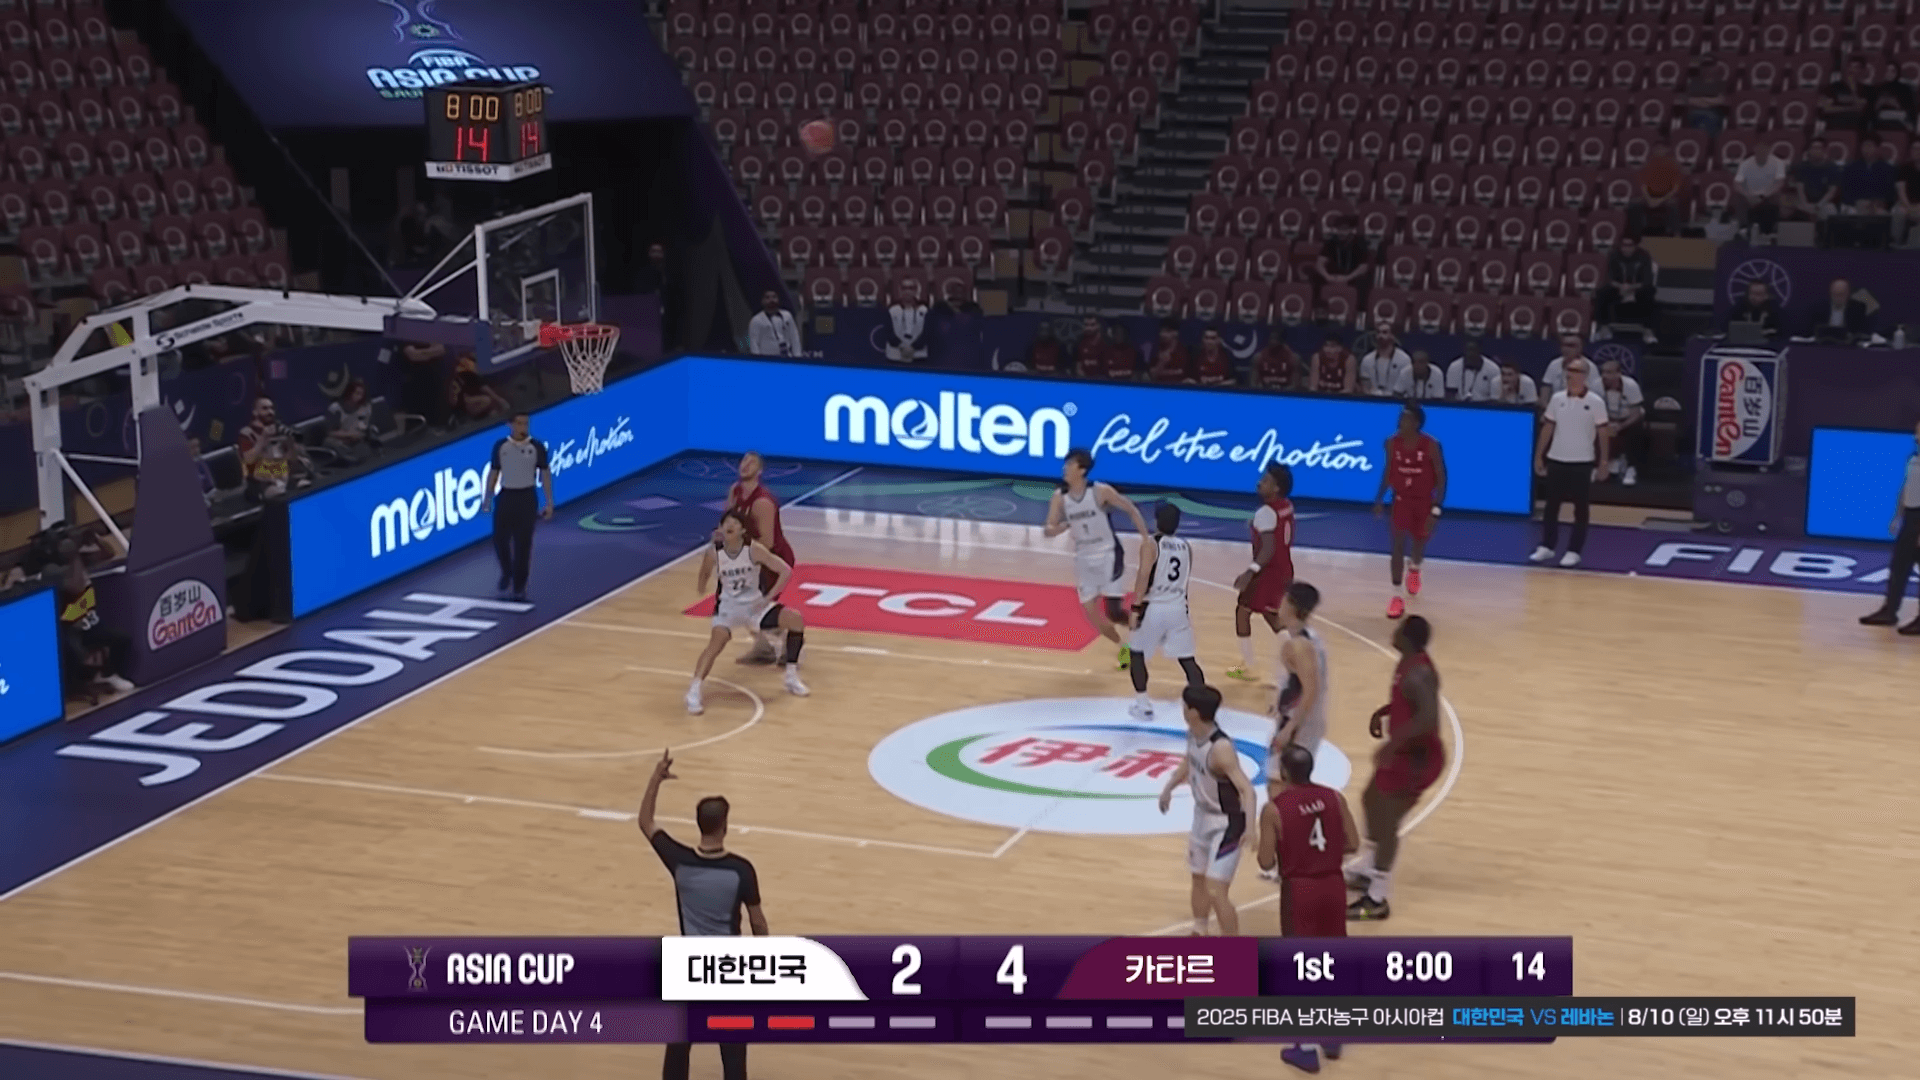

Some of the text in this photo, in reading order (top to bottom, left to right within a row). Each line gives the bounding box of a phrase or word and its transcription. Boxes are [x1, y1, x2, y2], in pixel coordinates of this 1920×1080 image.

[367, 68, 457, 88] ASIA
[456, 127, 489, 163] 14
[1091, 413, 1170, 464] feel
[1164, 427, 1228, 463] the
[1167, 556, 1181, 582] 3
[160, 586, 202, 618] 百岁山
[799, 582, 1048, 627] TCL
[56, 592, 536, 787] JEDDAH
[1309, 818, 1327, 852] 4
